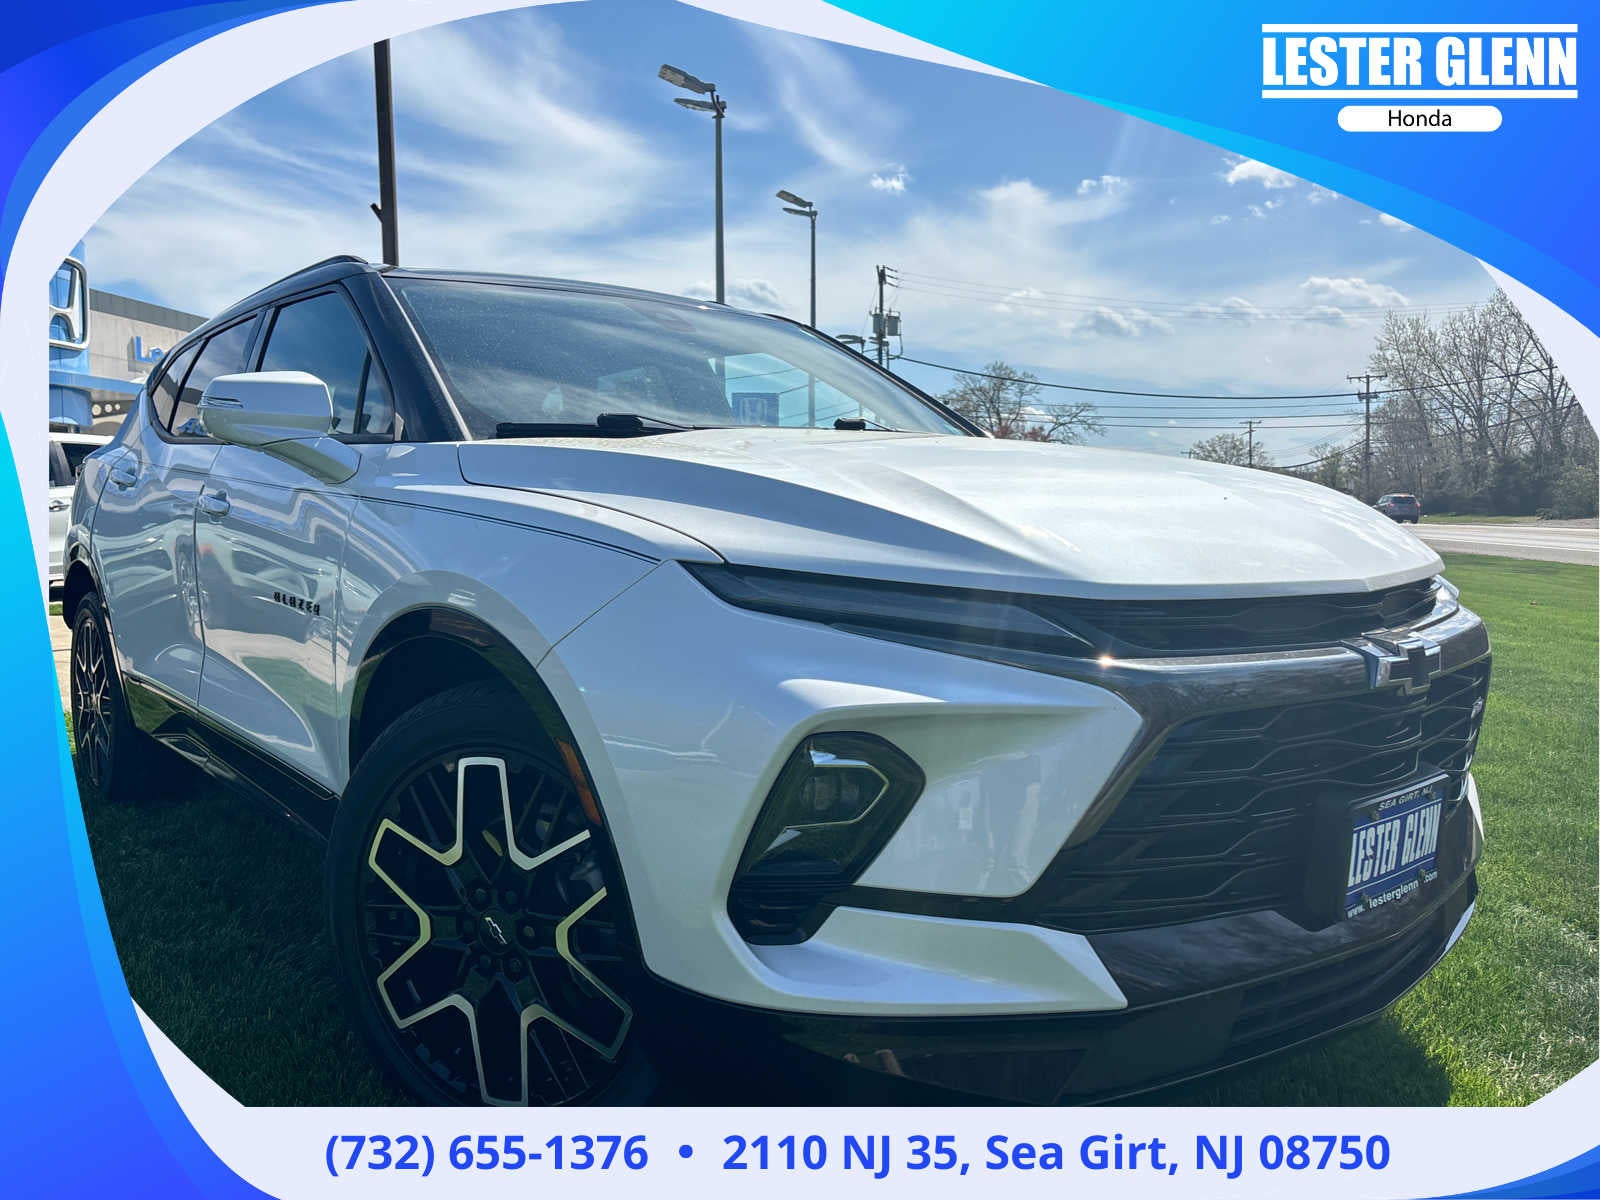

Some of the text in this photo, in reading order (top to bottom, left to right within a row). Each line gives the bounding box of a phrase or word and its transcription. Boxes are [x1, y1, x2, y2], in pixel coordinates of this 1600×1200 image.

[273, 591, 320, 616] BLAZER
[1378, 799, 1397, 811] SEA
[1421, 785, 1433, 797] NJ
[1348, 803, 1442, 888] LESTER GLENN
